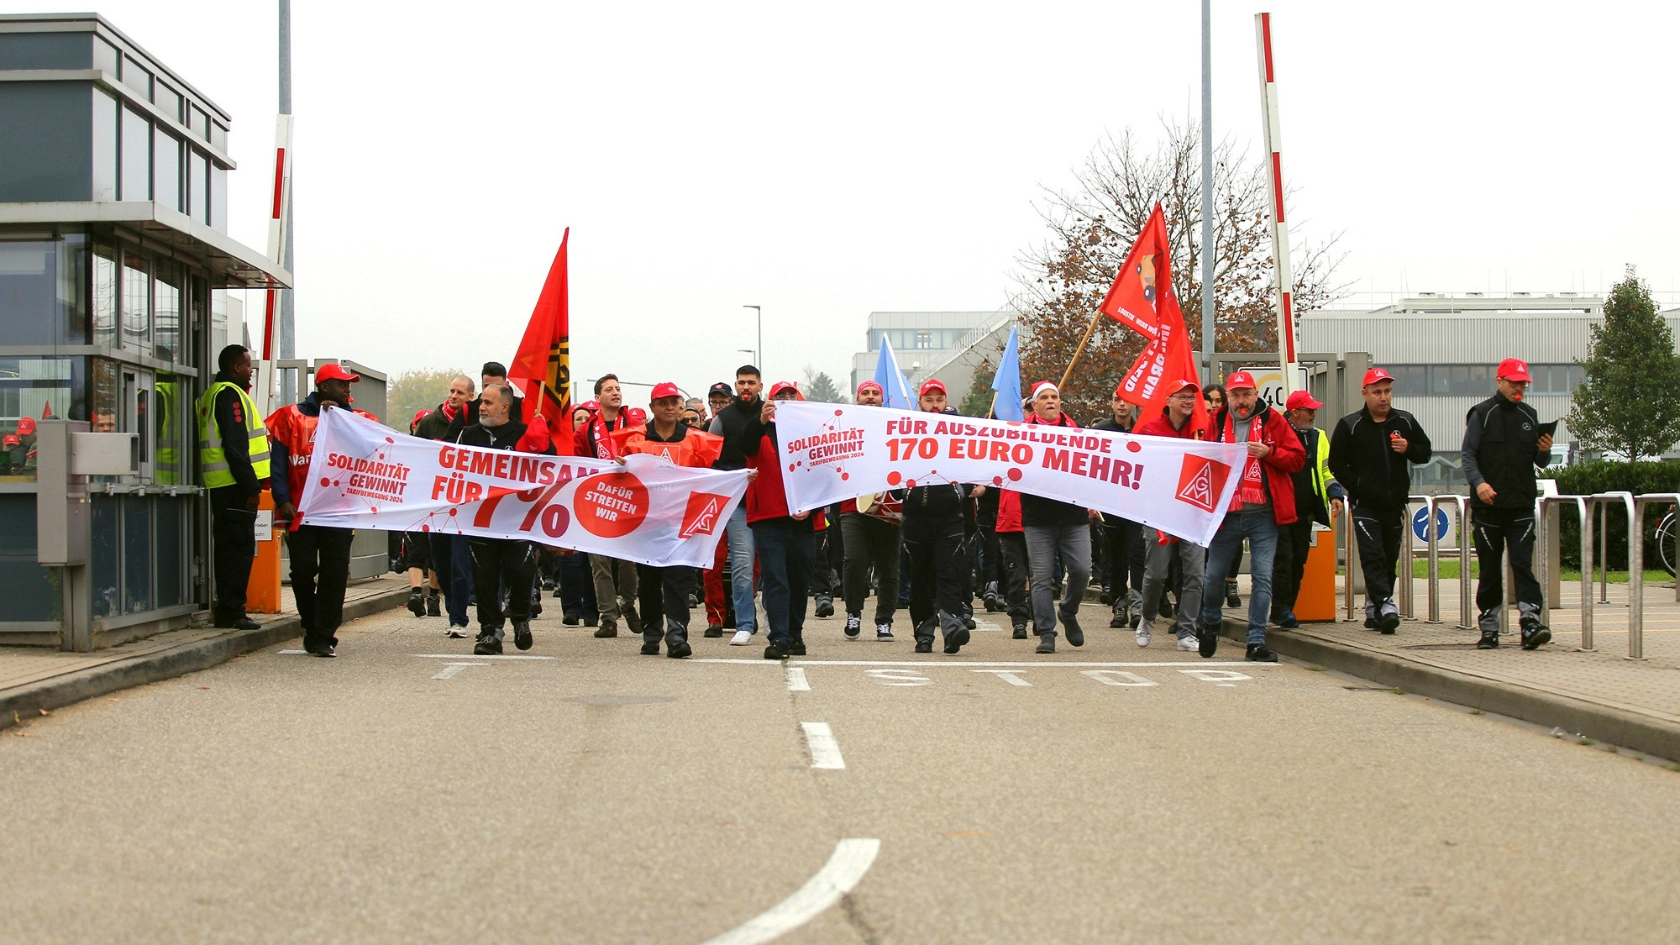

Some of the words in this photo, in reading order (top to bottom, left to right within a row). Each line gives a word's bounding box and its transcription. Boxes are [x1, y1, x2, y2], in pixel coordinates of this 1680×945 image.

[787, 427, 865, 455] SOLIDARITÄT
[886, 416, 928, 435] FÜR
[934, 420, 1113, 454] AUSZUBILDENDE
[288, 454, 311, 467] War
[808, 440, 865, 460] GEWINNT
[809, 454, 850, 467] TARIFBEWEGUNG
[327, 453, 411, 480] SOLIDARITÄT
[885, 437, 939, 461] 170
[948, 437, 1033, 465] EURO
[1042, 447, 1144, 490] MEHR!
[349, 473, 407, 495] GEWINNT
[596, 481, 634, 500] DAFÜR
[346, 487, 389, 501] TARIFBEWEGUNG
[388, 495, 403, 503] 2024
[431, 471, 483, 504] FÜR
[473, 479, 571, 538] 7%
[584, 490, 637, 515] STREITEN
[595, 506, 618, 522] WIR
[864, 668, 1253, 687] STOP
